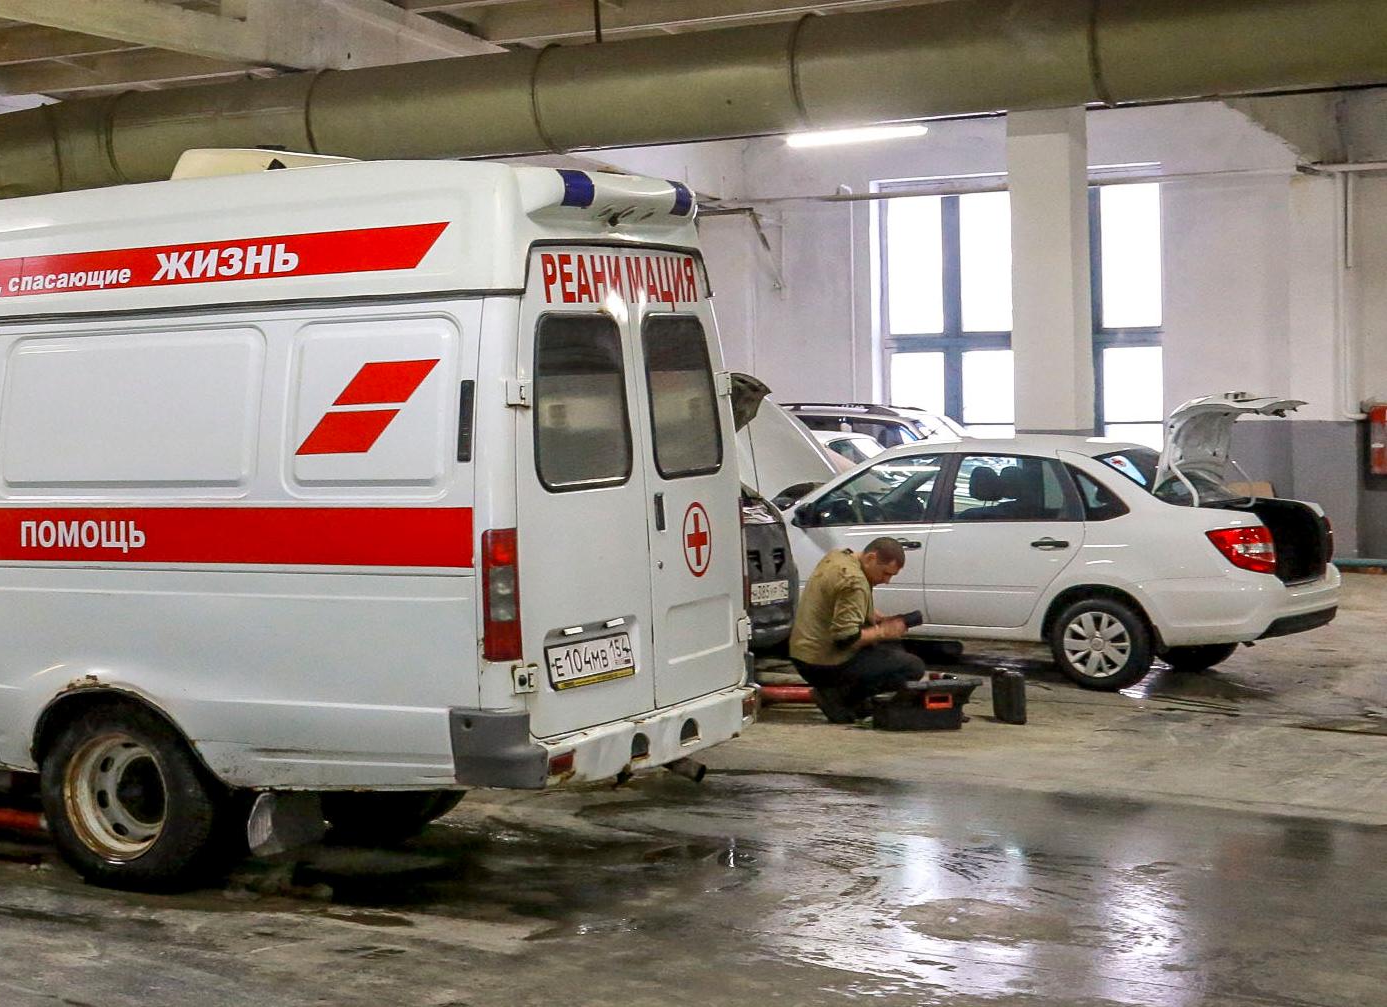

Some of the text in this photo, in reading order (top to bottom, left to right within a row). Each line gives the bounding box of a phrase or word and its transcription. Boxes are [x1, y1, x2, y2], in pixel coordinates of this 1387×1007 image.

[9, 268, 132, 292] спасающие
[152, 243, 299, 281] ЖИЗНЬ
[20, 520, 146, 553] ПОМОЩЬ
[553, 637, 631, 677] Е104МВ 154
